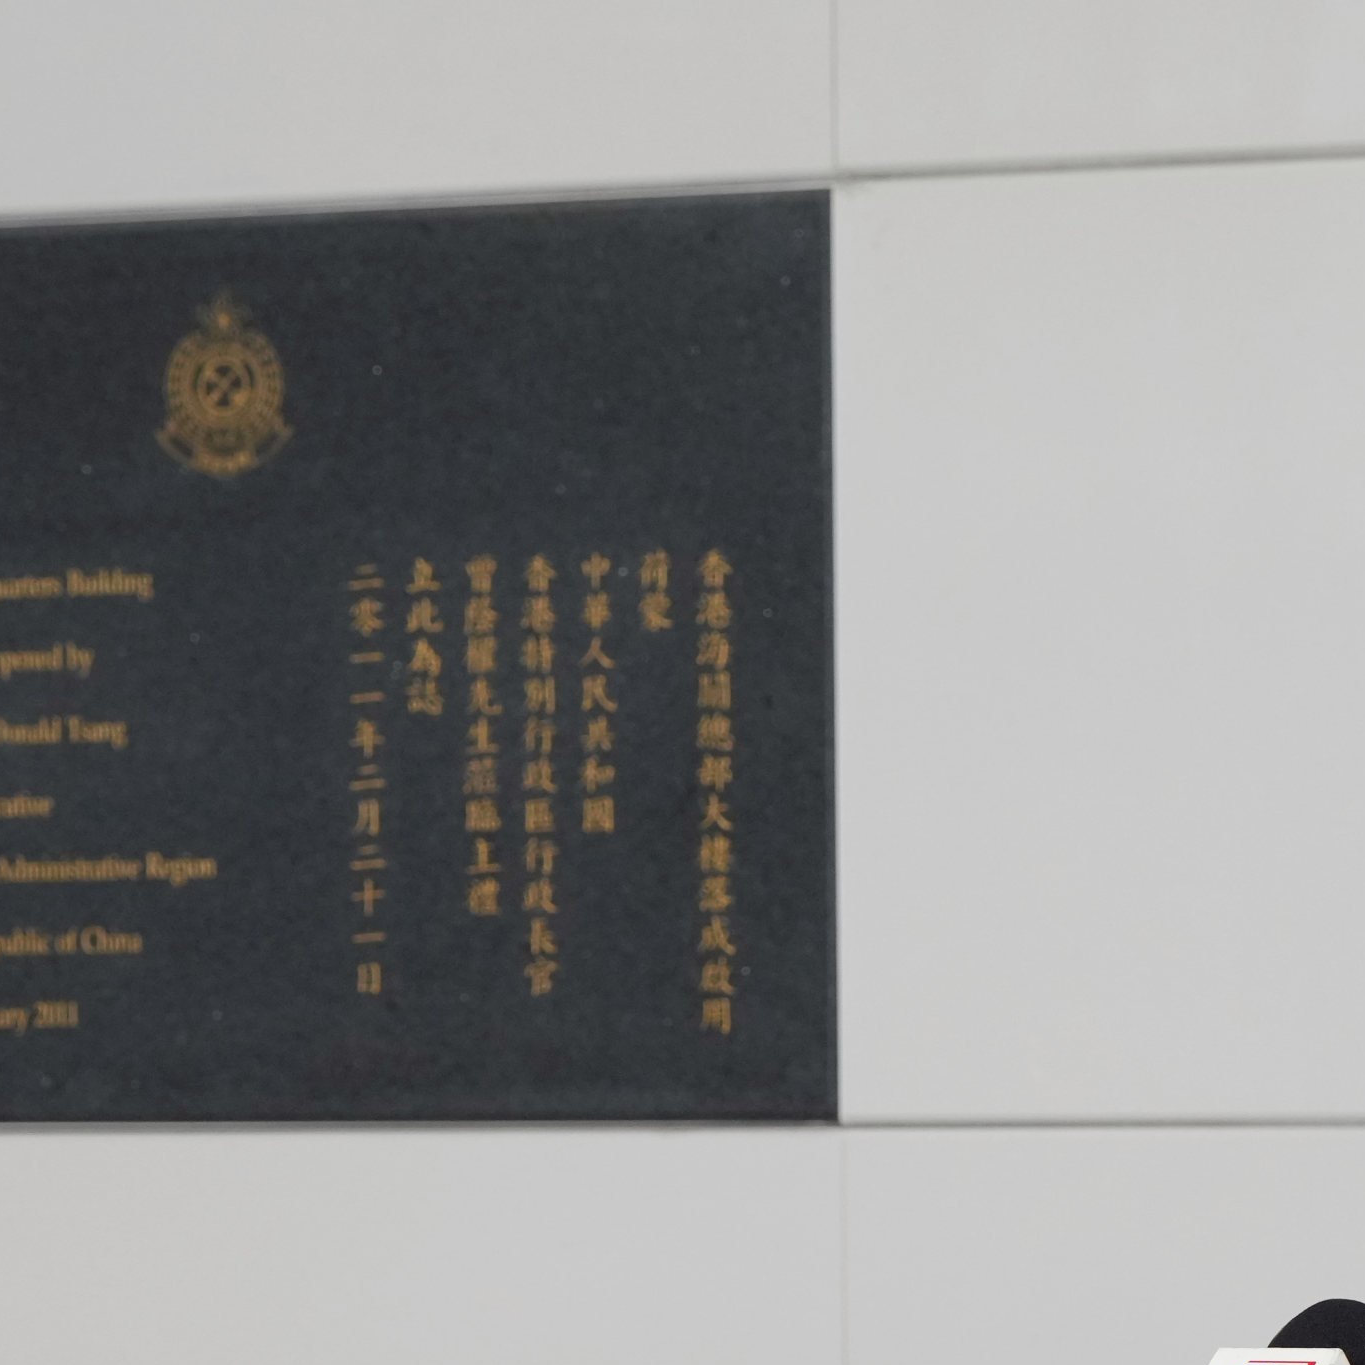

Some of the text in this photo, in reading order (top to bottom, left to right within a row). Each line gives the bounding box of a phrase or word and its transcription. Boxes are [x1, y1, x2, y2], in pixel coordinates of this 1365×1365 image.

[67, 569, 154, 600] Building
[66, 643, 95, 678] by
[68, 717, 128, 749] Tsang
[145, 852, 218, 887] Region
[79, 926, 144, 954] China
